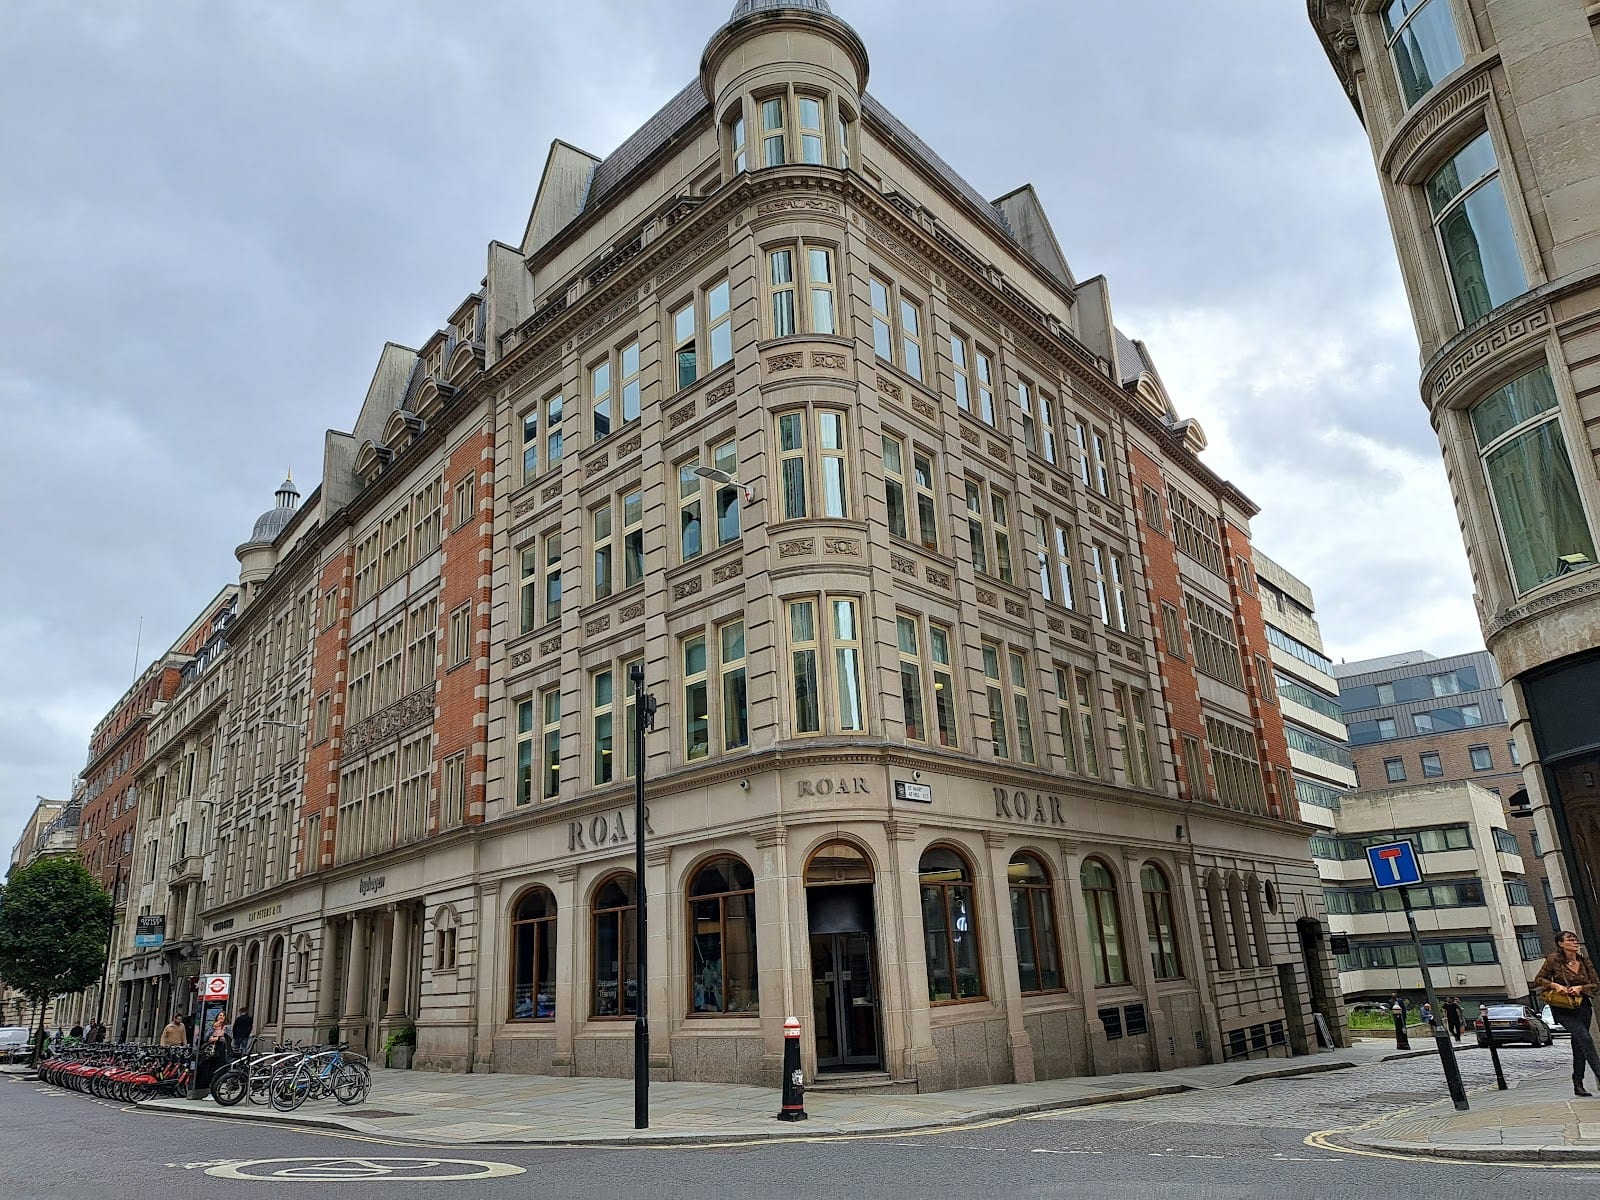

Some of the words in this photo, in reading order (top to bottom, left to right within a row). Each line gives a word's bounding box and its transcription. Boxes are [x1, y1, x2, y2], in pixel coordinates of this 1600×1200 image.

[797, 777, 870, 797] ROAR
[993, 787, 1066, 823] ROAR
[568, 806, 655, 851] ROAR
